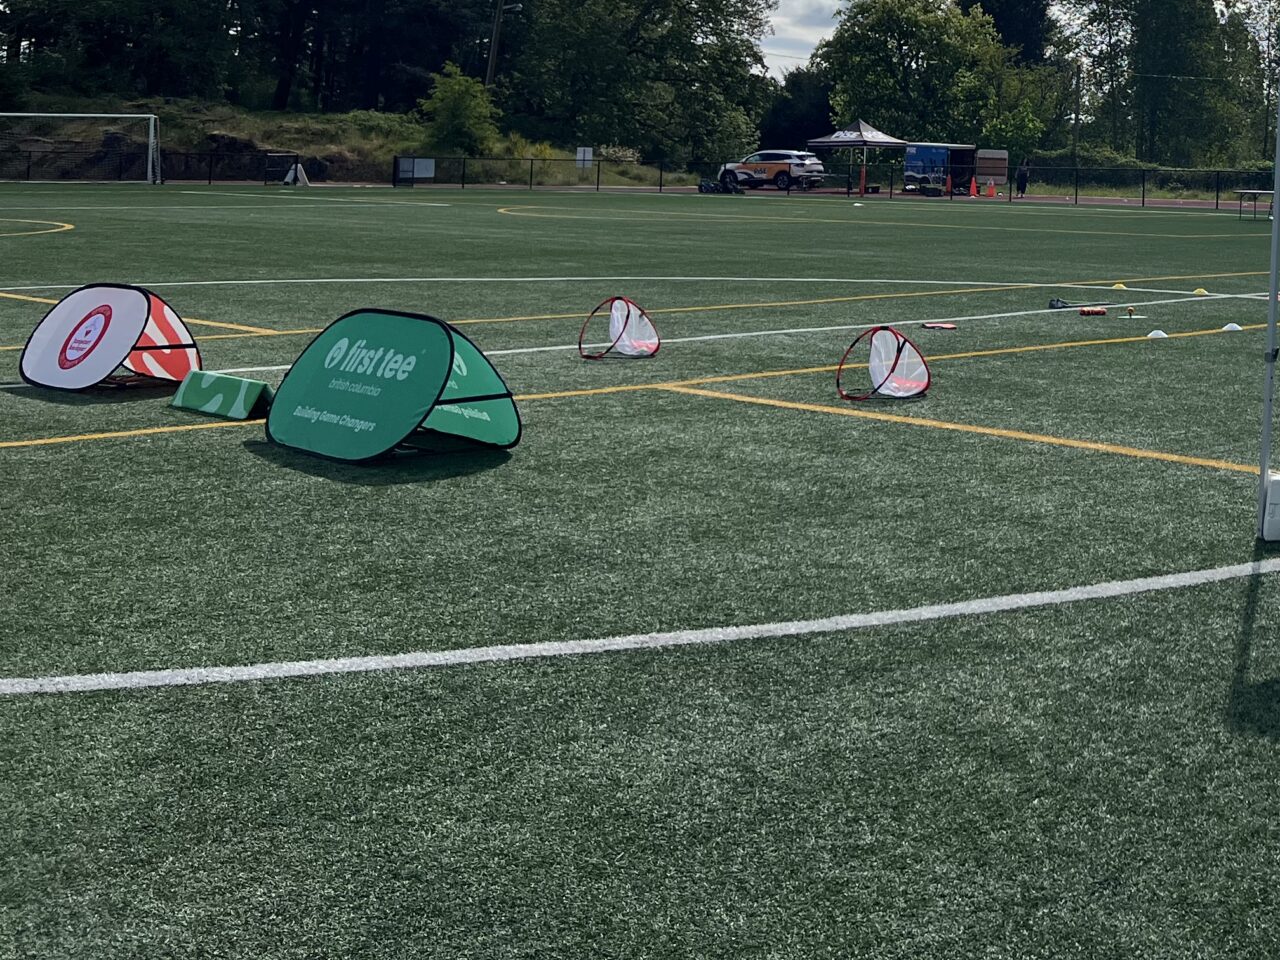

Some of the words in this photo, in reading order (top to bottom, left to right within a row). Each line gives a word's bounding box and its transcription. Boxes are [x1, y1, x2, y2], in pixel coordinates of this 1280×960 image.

[338, 339, 385, 376] first
[376, 348, 417, 380] tee
[293, 405, 321, 423] Building
[319, 410, 341, 424] Game
[340, 414, 377, 432] Changers
